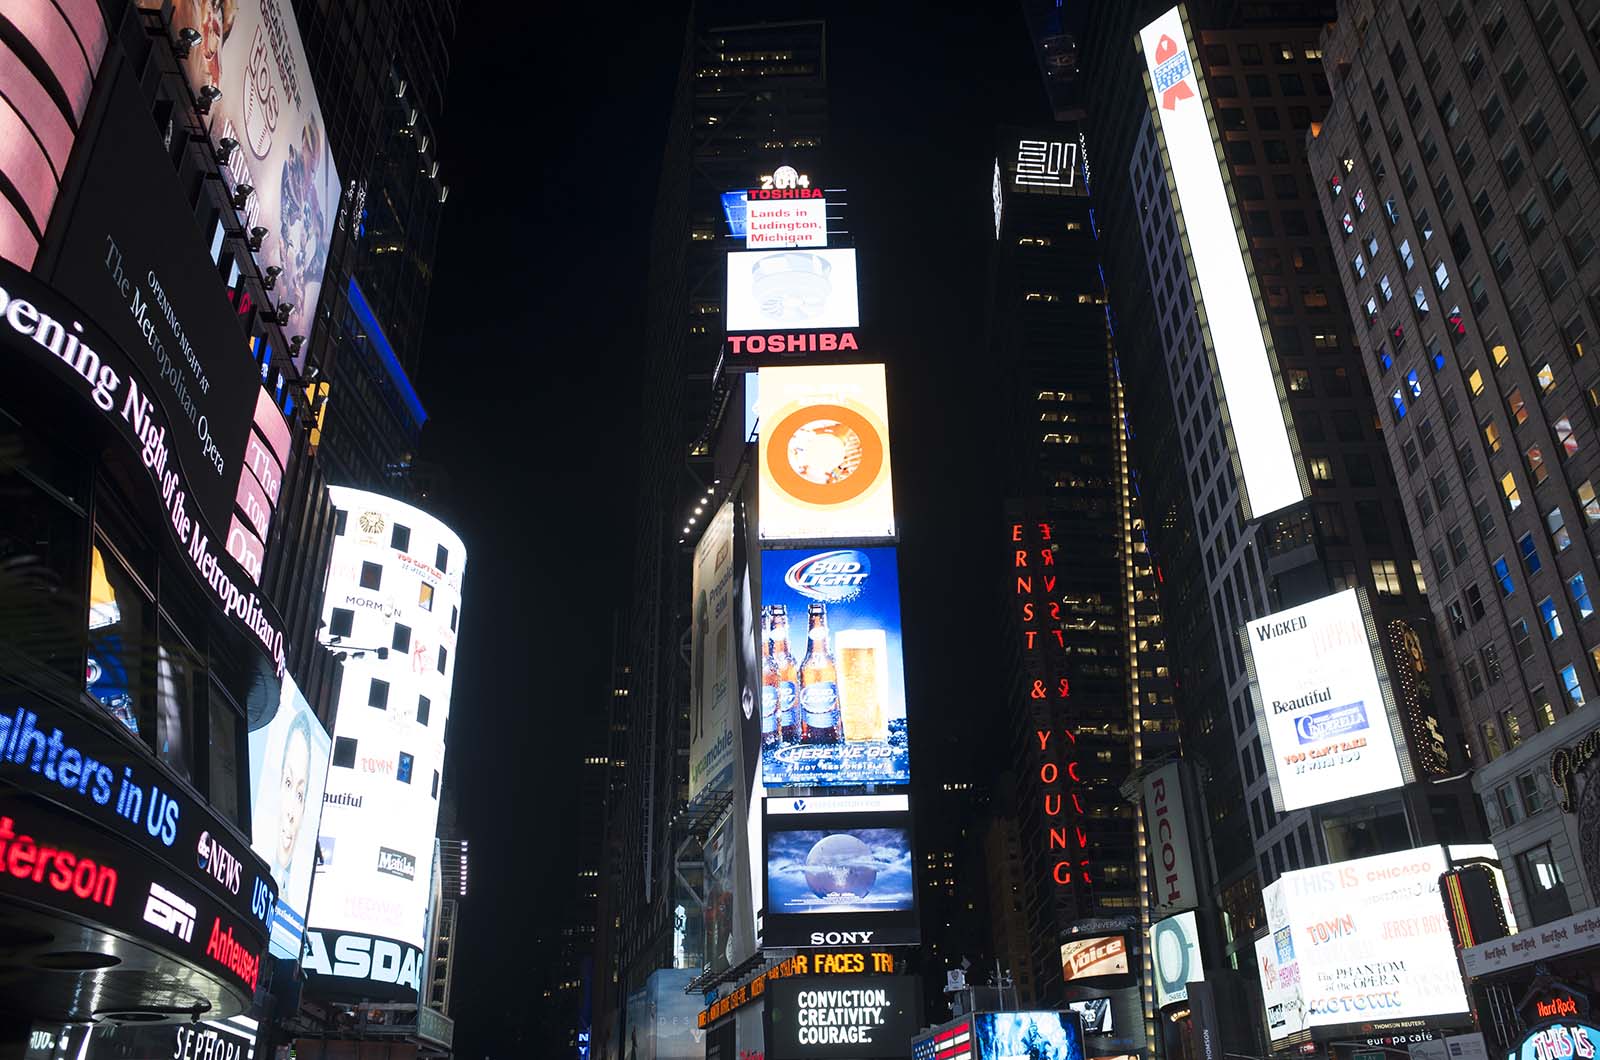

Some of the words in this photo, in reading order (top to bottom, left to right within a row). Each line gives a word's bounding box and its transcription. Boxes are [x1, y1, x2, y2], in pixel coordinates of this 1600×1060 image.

[748, 189, 824, 200] TOSHIBA
[751, 208, 791, 218] Lands
[796, 209, 808, 218] in
[751, 221, 823, 231] Ludington,
[751, 233, 813, 243] Michigan
[147, 269, 182, 338] OPENING
[180, 329, 204, 377] NIGHT
[200, 375, 211, 396] AT
[727, 332, 859, 353] TOSHIBA
[105, 233, 131, 299] The
[130, 289, 198, 425] Metropolitan
[197, 415, 226, 476] Opera
[120, 375, 166, 483] Night
[162, 470, 179, 512] of
[171, 491, 191, 545] the
[188, 520, 279, 652] Metropolitan
[810, 561, 862, 574] BUD
[800, 572, 869, 586] LIGHT
[346, 595, 402, 618] MORMN
[1272, 687, 1333, 715] Beautiful
[788, 748, 835, 760] HERE
[835, 747, 864, 759] WE
[866, 746, 893, 759] GO
[1284, 752, 1307, 766] YOU
[1308, 745, 1340, 760] CAN'T
[116, 766, 143, 825] in
[146, 786, 180, 848] US
[1151, 777, 1182, 903] RICOH
[206, 838, 243, 896] NEWS
[1366, 861, 1433, 883] CHICAGO
[1338, 867, 1360, 890] IS
[251, 875, 268, 921] US
[144, 882, 198, 944] ESPN
[810, 931, 875, 947] SONY
[1305, 914, 1358, 946] TOWN
[1381, 917, 1420, 943] JERSEY
[813, 953, 865, 975] FACES
[1070, 940, 1123, 976] Voice
[1335, 959, 1408, 978] PHANTOM
[1352, 974, 1401, 989] OPERA
[798, 988, 891, 1009] CONVICTION.
[1308, 990, 1403, 1015] MOTOWN
[1536, 1001, 1557, 1018] Hard
[1554, 995, 1578, 1017] Rock
[798, 1007, 886, 1026] CREATIVITY.
[1374, 1022, 1400, 1031] THOMSON
[1401, 1019, 1426, 1028] REUTERS
[174, 1026, 242, 1060] SEPHORA
[798, 1025, 874, 1045] COURAGE.
[1202, 1028, 1213, 1060] HOMSON
[1408, 1028, 1433, 1043] café
[1534, 1026, 1573, 1060] THIS
[1569, 1026, 1596, 1060] IS
